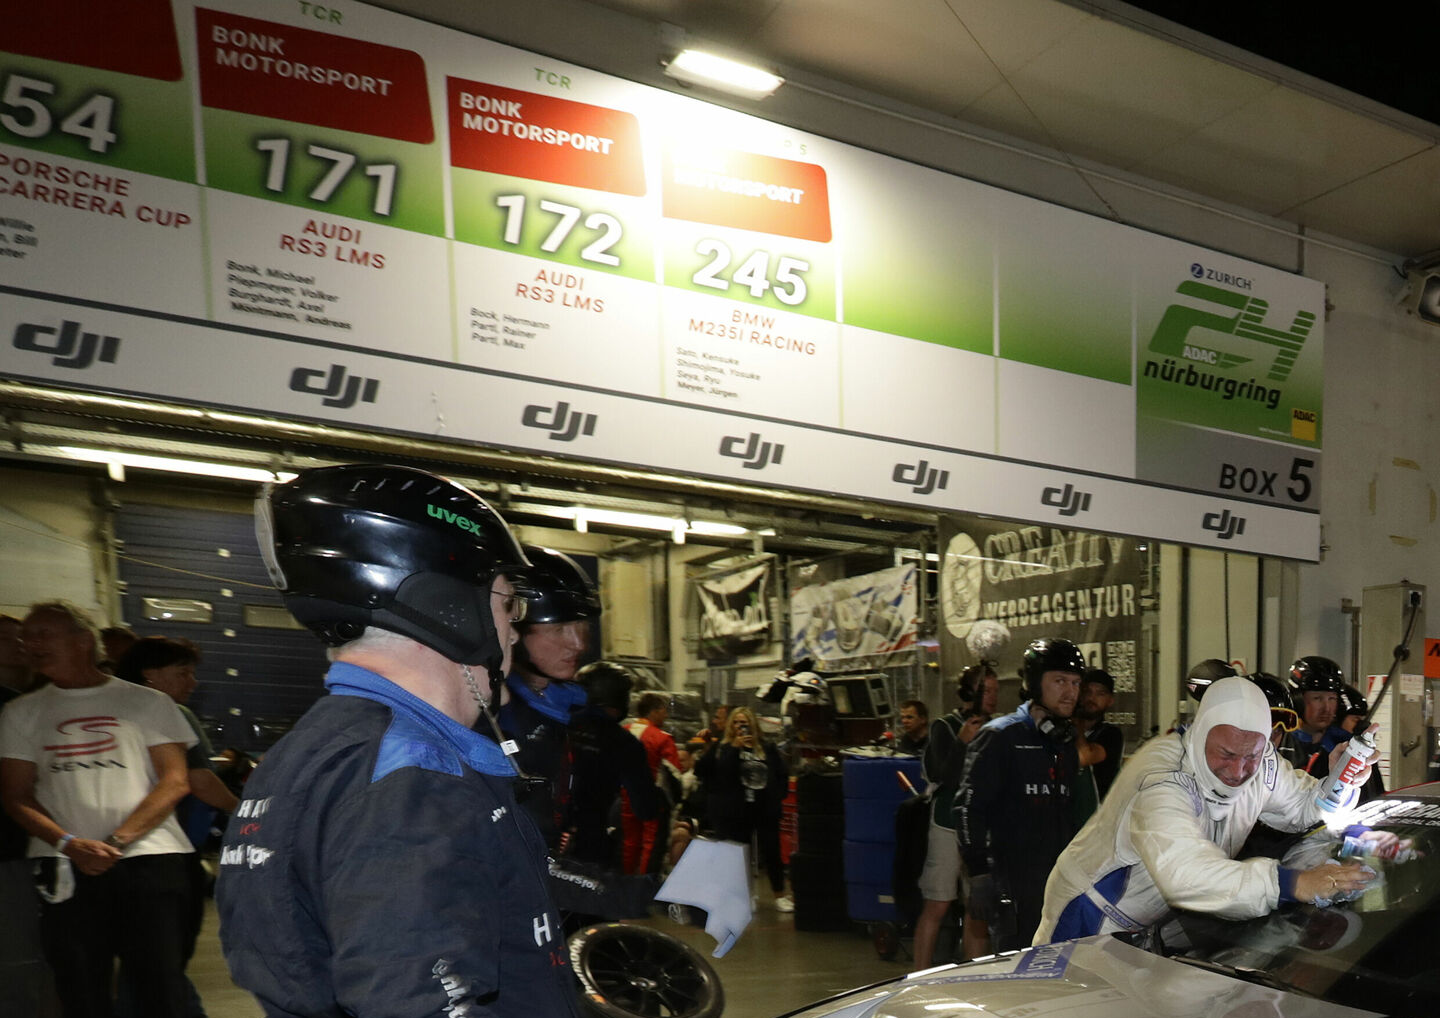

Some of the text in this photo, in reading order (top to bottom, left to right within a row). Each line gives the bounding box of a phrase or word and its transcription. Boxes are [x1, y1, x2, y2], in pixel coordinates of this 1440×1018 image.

[300, 3, 342, 25] TCR
[213, 25, 284, 55] BONK
[216, 48, 392, 96] MOTORSPORT
[535, 68, 571, 89] TCR
[460, 92, 522, 118] BONK
[462, 113, 614, 155] MOTORSPORT
[257, 139, 396, 215] 171
[136, 206, 192, 229] CUP
[303, 219, 362, 244] AUDI
[497, 194, 622, 266] 172
[280, 234, 386, 269] RS3 LMS
[535, 269, 584, 290] AUDI
[692, 237, 810, 306] 245
[1206, 269, 1252, 290] ZURICH
[516, 283, 605, 313] RS3 LMS
[689, 318, 816, 355] M235I RACING
[732, 310, 776, 329] BMW
[1182, 346, 1217, 364] ADAC
[1143, 359, 1281, 410] nürburgring
[1286, 458, 1315, 503] 5
[427, 503, 483, 537] uvex
[984, 526, 1126, 584] CREATIV
[983, 584, 1135, 628] WERBEAGENTUR
